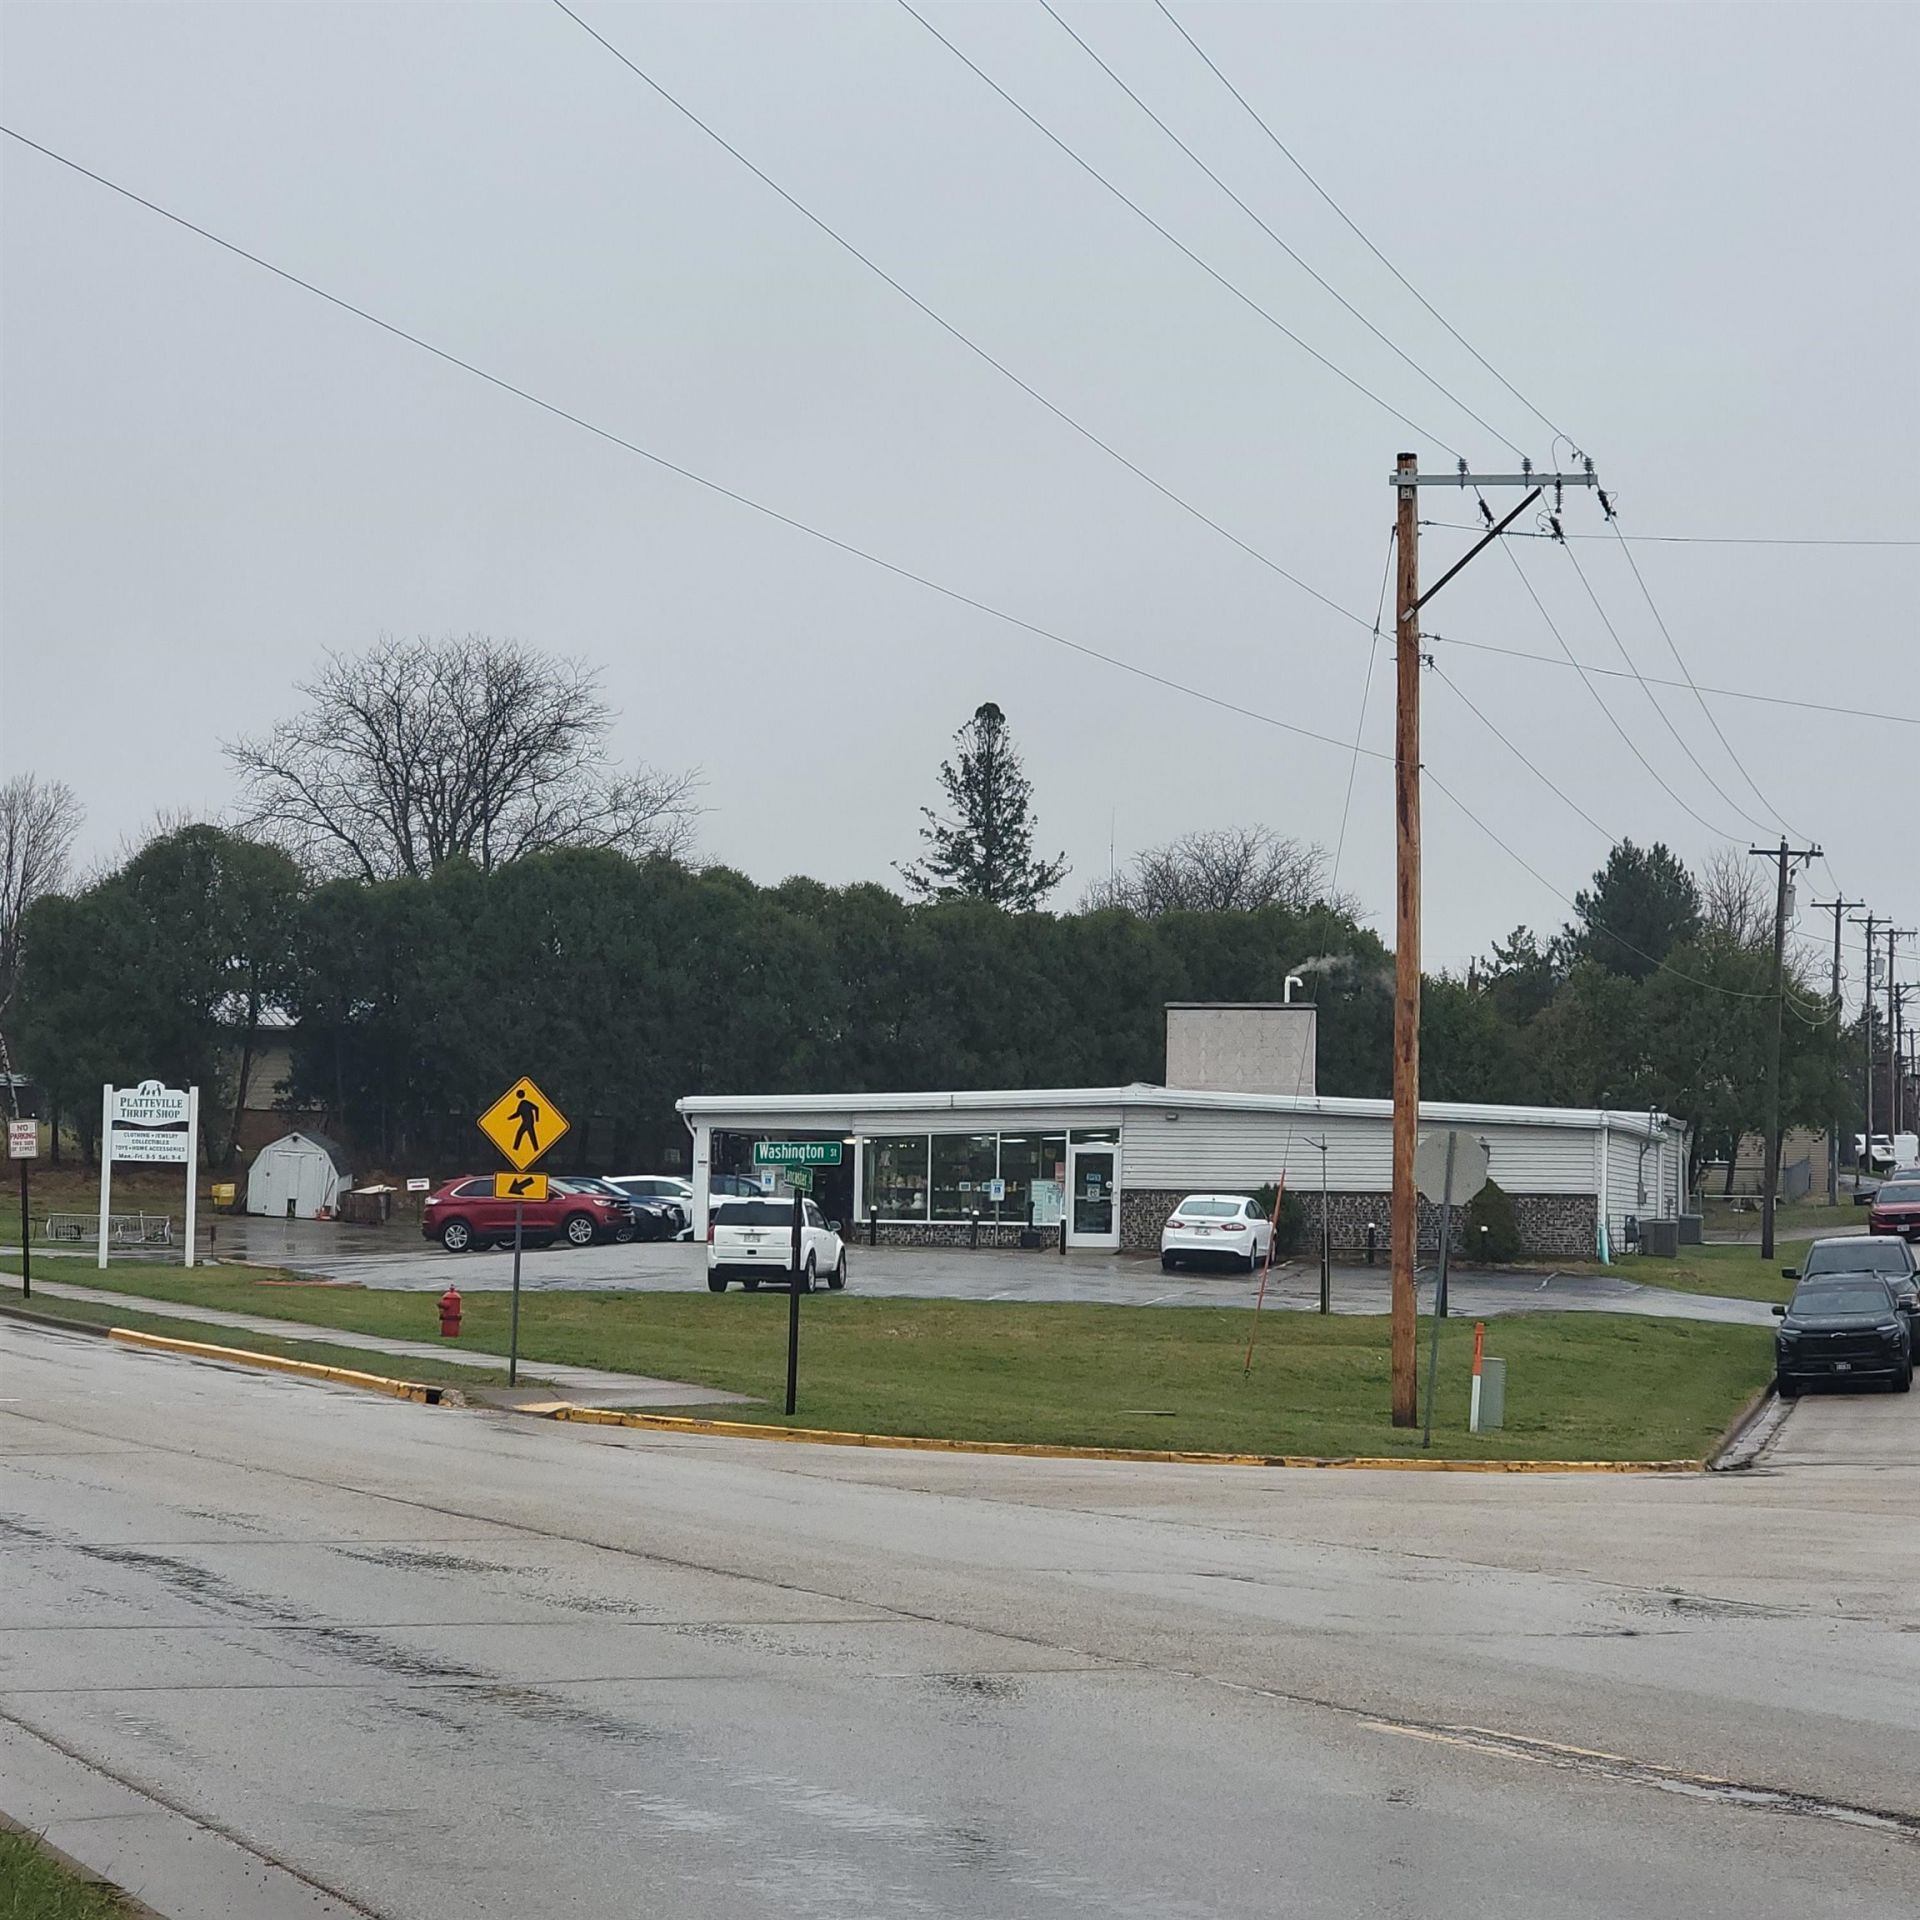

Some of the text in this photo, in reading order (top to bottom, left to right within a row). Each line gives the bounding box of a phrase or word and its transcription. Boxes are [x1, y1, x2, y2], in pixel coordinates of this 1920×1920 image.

[120, 1097, 183, 1108] PLATTEVILLE
[120, 1108, 180, 1119] THRIFT SHOP
[760, 1144, 824, 1163] Washington
